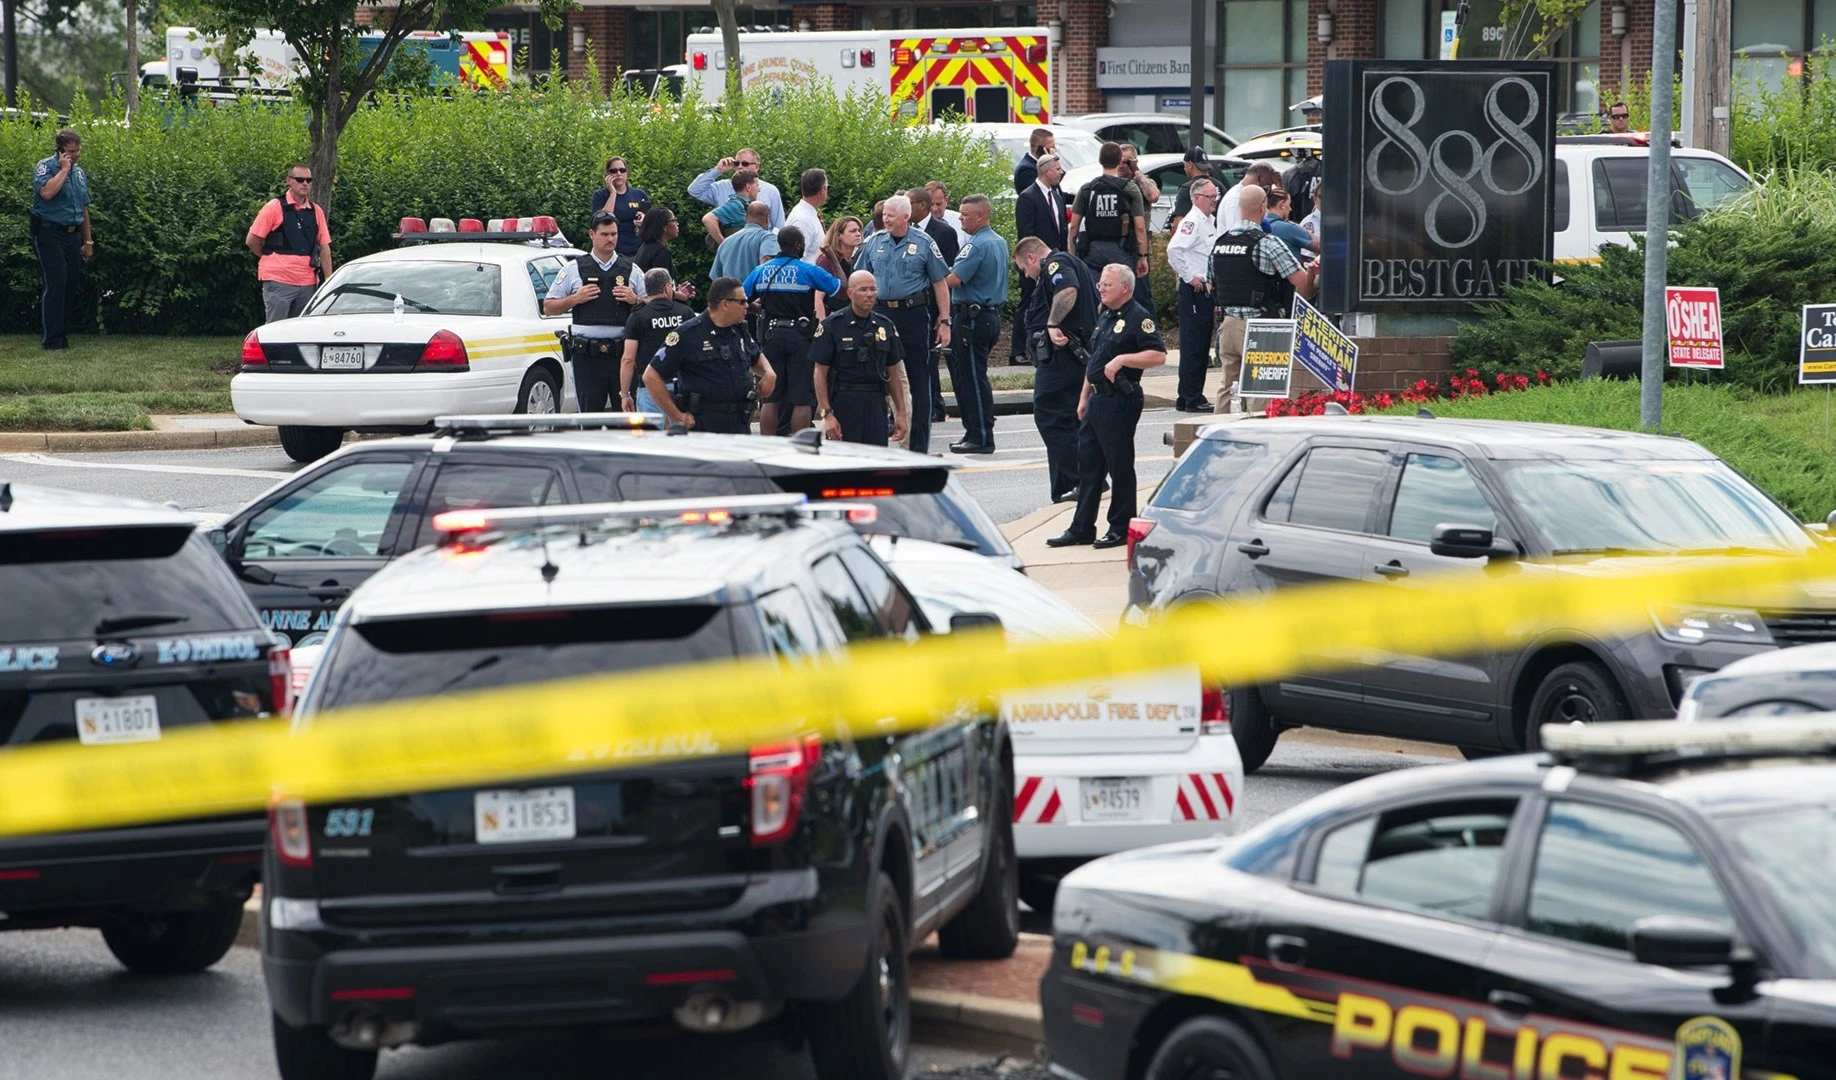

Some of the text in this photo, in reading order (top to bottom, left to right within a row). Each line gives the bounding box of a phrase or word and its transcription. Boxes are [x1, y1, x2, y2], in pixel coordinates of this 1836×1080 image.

[1107, 59, 1191, 75] First Citizens Ban
[1096, 194, 1118, 211] ATF
[1213, 245, 1248, 255] POLICE
[651, 315, 683, 329] POLICE
[1669, 293, 1719, 339] O'SHEA
[1306, 308, 1354, 354] SHERIFF
[1303, 319, 1353, 374] BATEMAN
[1672, 347, 1720, 361] STATE DELEGATE
[334, 352, 361, 363] 84760
[1245, 351, 1290, 365] FREDERICKS
[1257, 367, 1289, 380] SHERIFF
[261, 609, 312, 630] ANNE
[156, 640, 191, 664] K-9
[114, 706, 153, 731] 1807
[1011, 702, 1101, 723] ANNAPOLIS
[1108, 703, 1140, 720] FIRE
[520, 800, 570, 829] 1853
[1331, 991, 1673, 1080] POLICE
